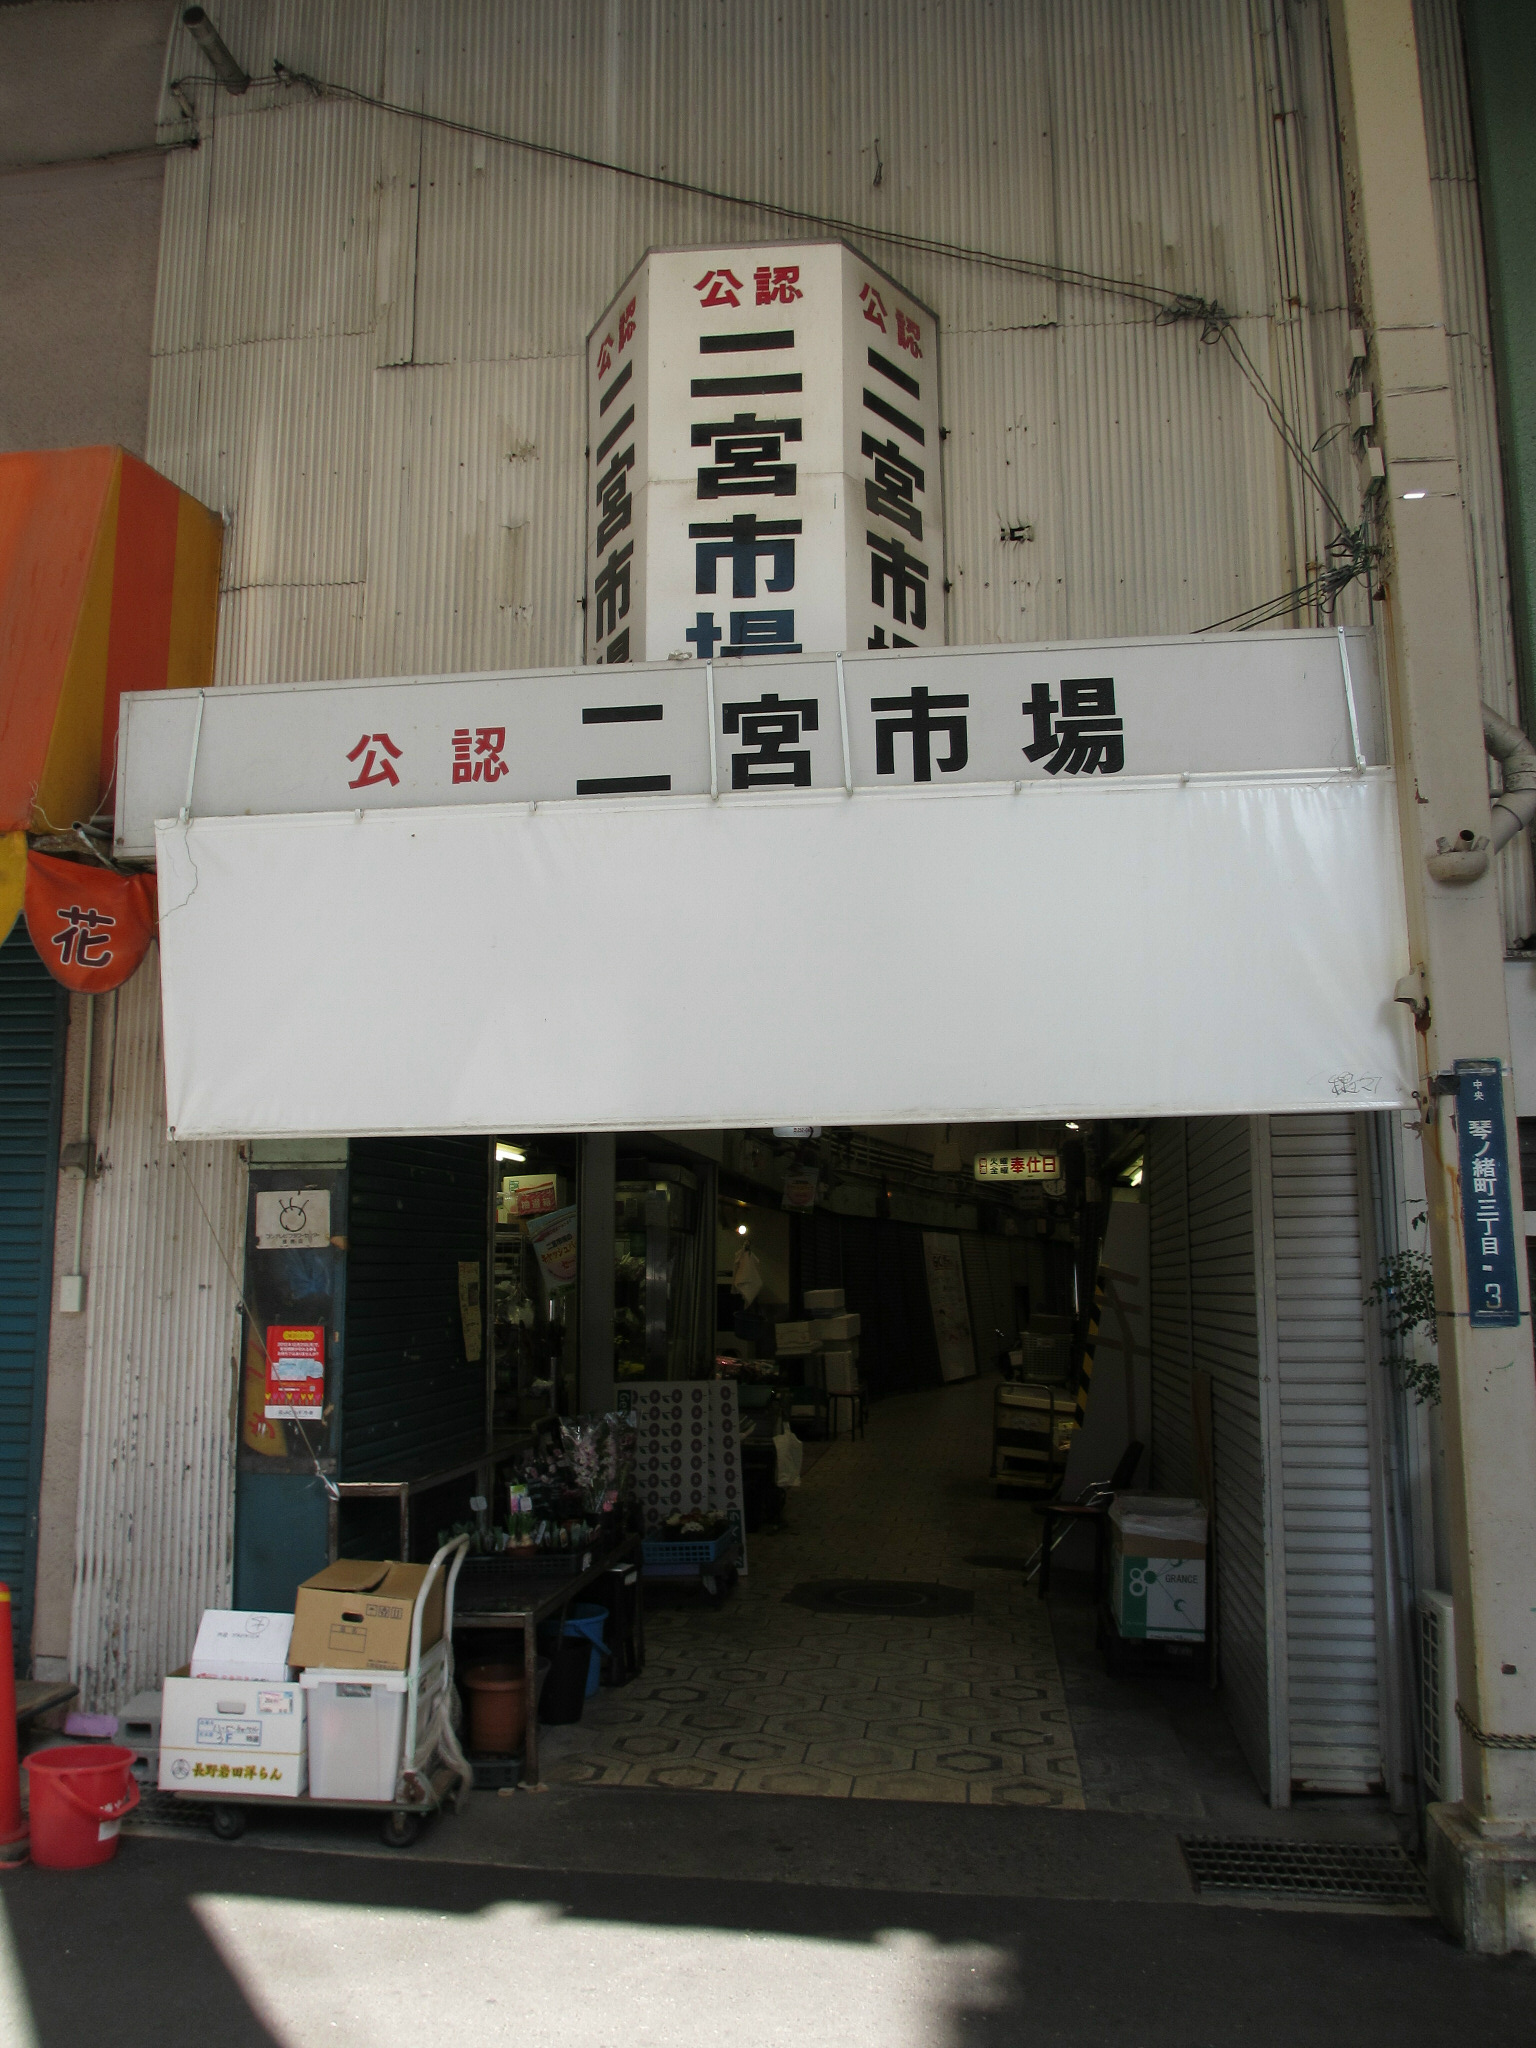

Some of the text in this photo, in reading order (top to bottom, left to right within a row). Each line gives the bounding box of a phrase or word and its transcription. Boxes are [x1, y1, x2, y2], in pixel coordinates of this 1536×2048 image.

[693, 265, 803, 308] 公認
[596, 295, 637, 380] 公認
[859, 282, 923, 359] 公認
[861, 346, 929, 650] 二宮市
[345, 677, 1125, 796] 公認 二宮市場
[51, 905, 116, 968] 花
[1473, 1079, 1485, 1101] 中央
[1010, 1156, 1056, 1174] 奉仕日
[1165, 1574, 1199, 1584] GRANCE
